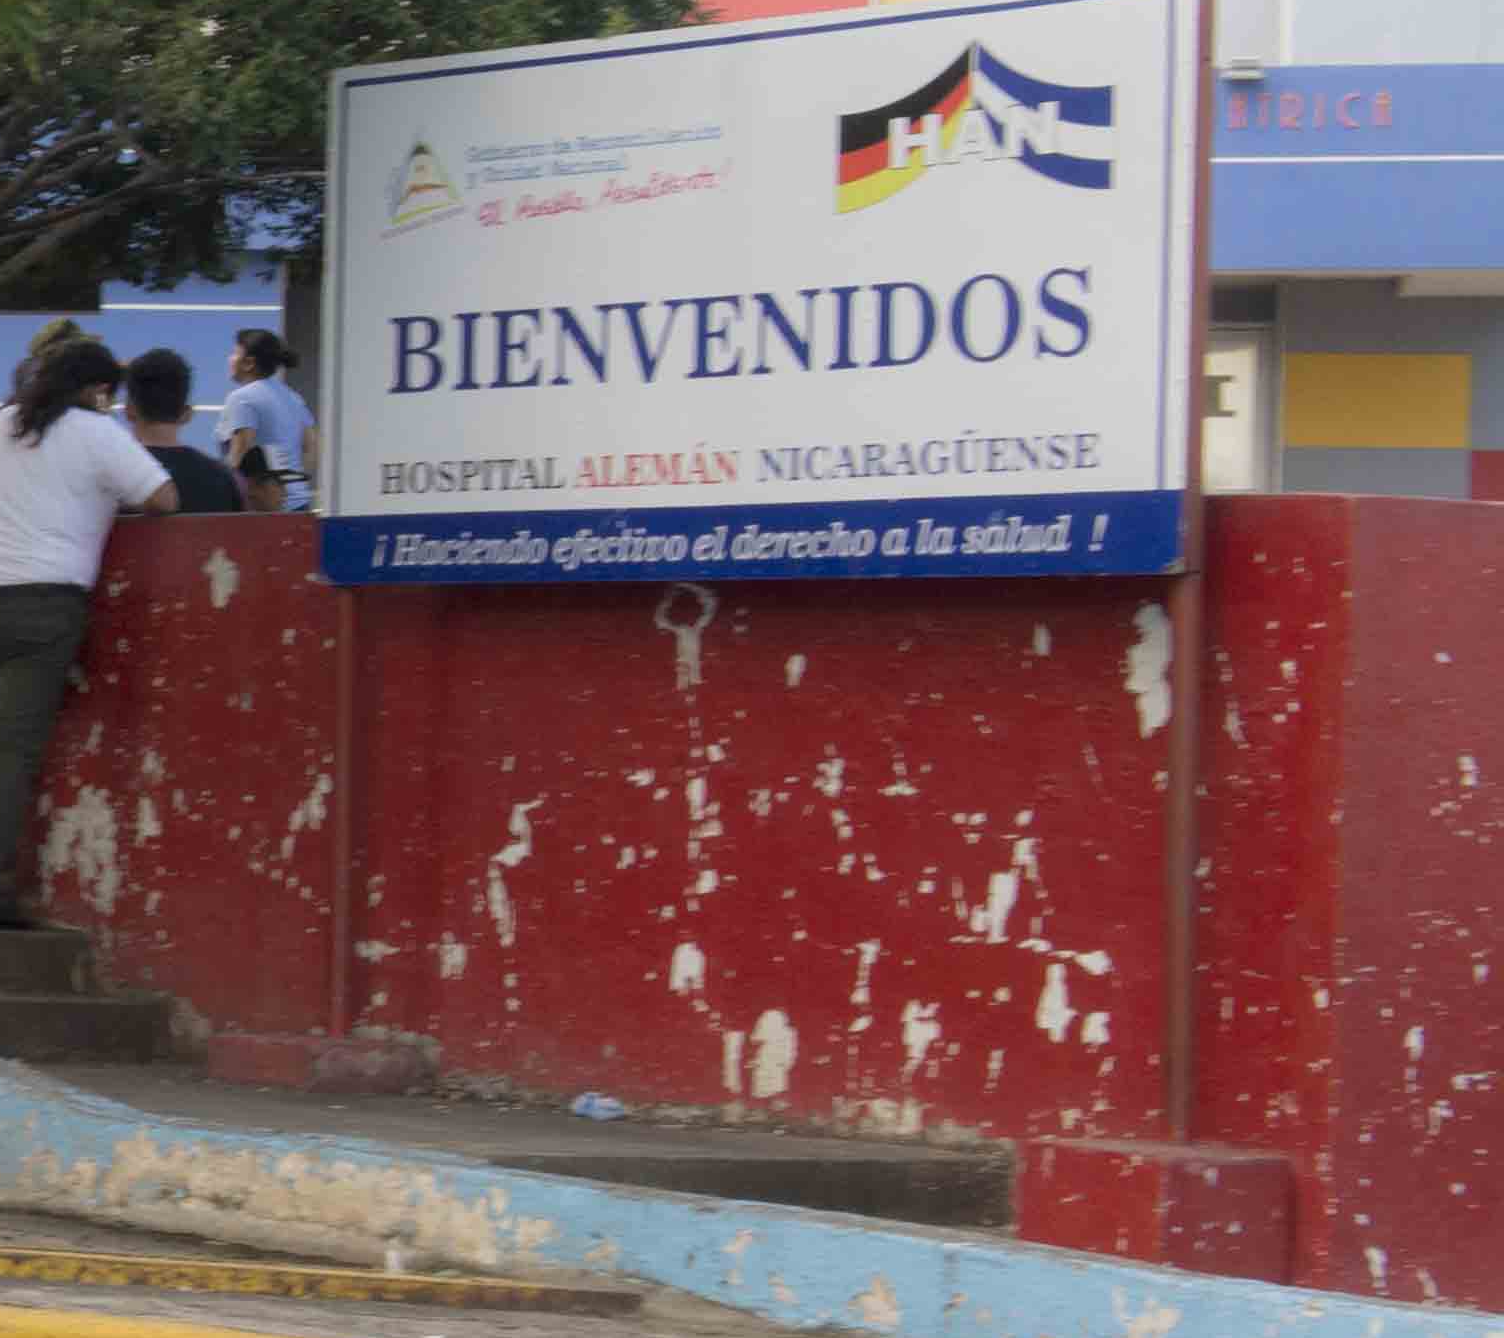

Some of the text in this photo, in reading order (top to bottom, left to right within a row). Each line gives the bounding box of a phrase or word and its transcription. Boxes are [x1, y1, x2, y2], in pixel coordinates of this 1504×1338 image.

[889, 101, 1058, 169] HAN
[387, 265, 1093, 395] BIENVENIDOS
[379, 429, 1101, 495] HOSPITAL ALEMÁN NICARAGÜENSE
[391, 530, 549, 567] Haciendo
[551, 527, 687, 571] efectivo
[691, 524, 729, 561] el
[731, 520, 877, 561] derecho
[880, 525, 911, 556] a
[913, 517, 958, 555] la
